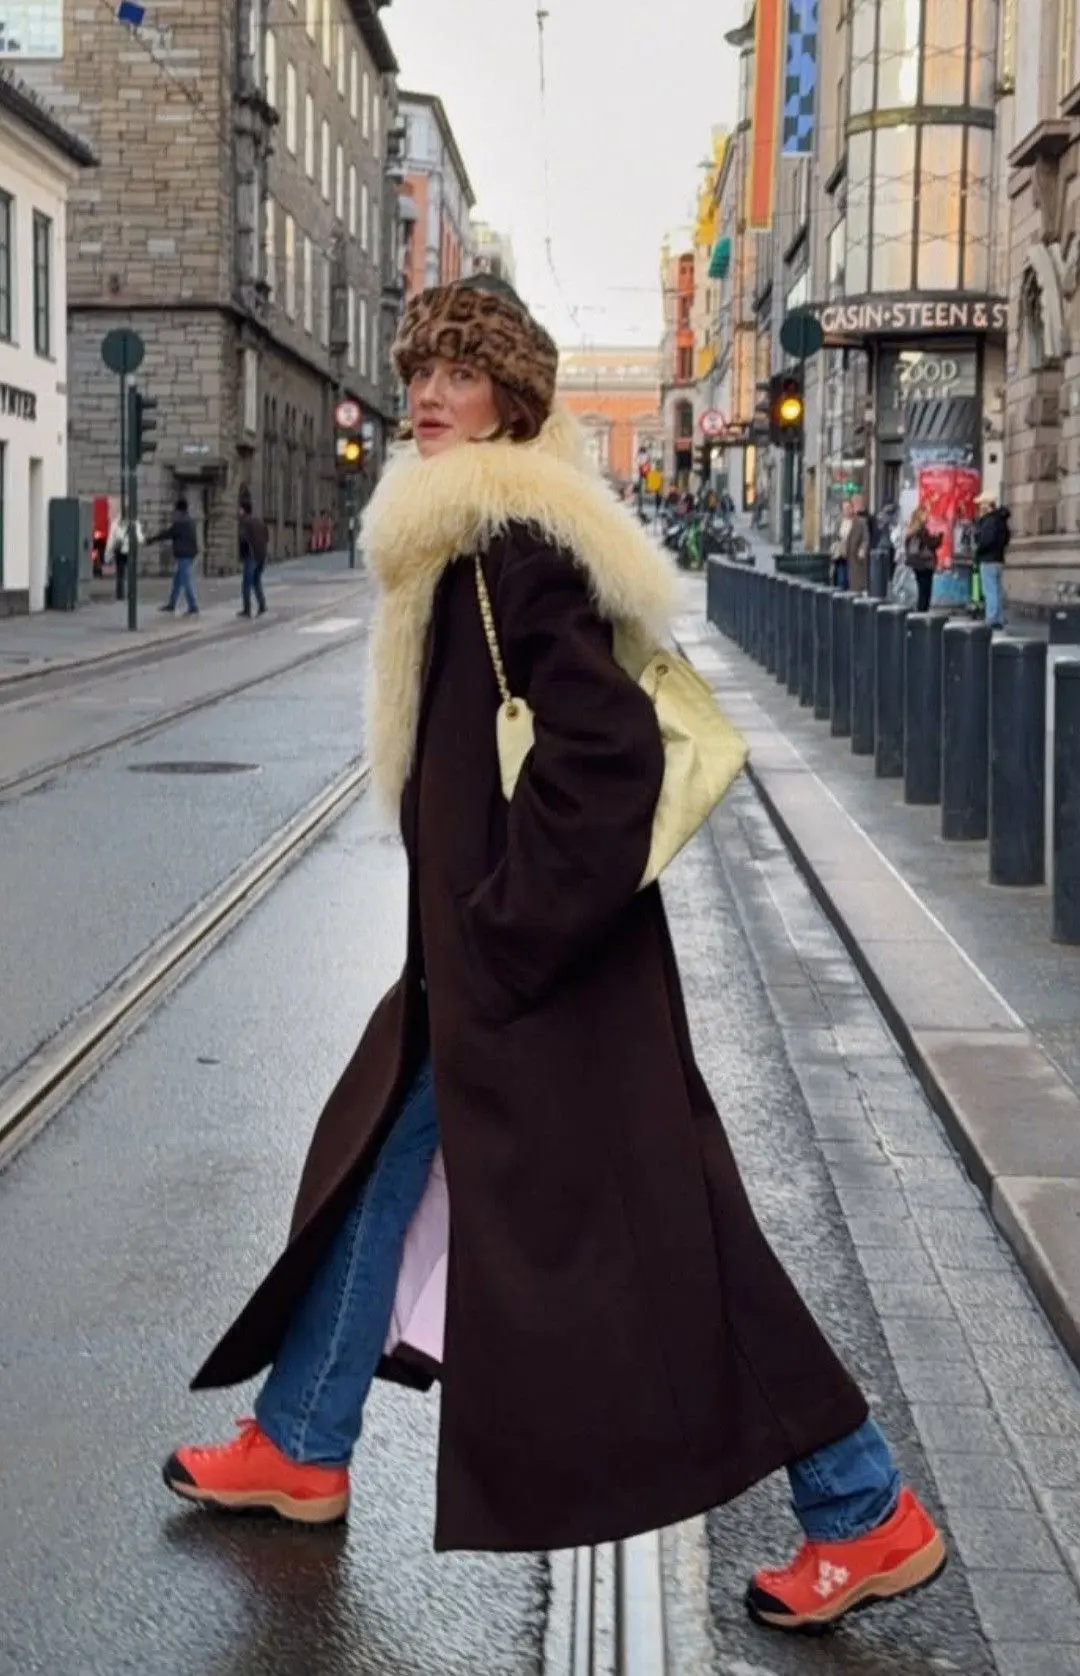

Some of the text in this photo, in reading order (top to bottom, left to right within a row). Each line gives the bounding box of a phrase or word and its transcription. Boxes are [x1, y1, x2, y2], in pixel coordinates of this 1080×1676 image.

[813, 303, 883, 331] GASIN
[892, 302, 968, 328] STEEN
[973, 302, 988, 328] &
